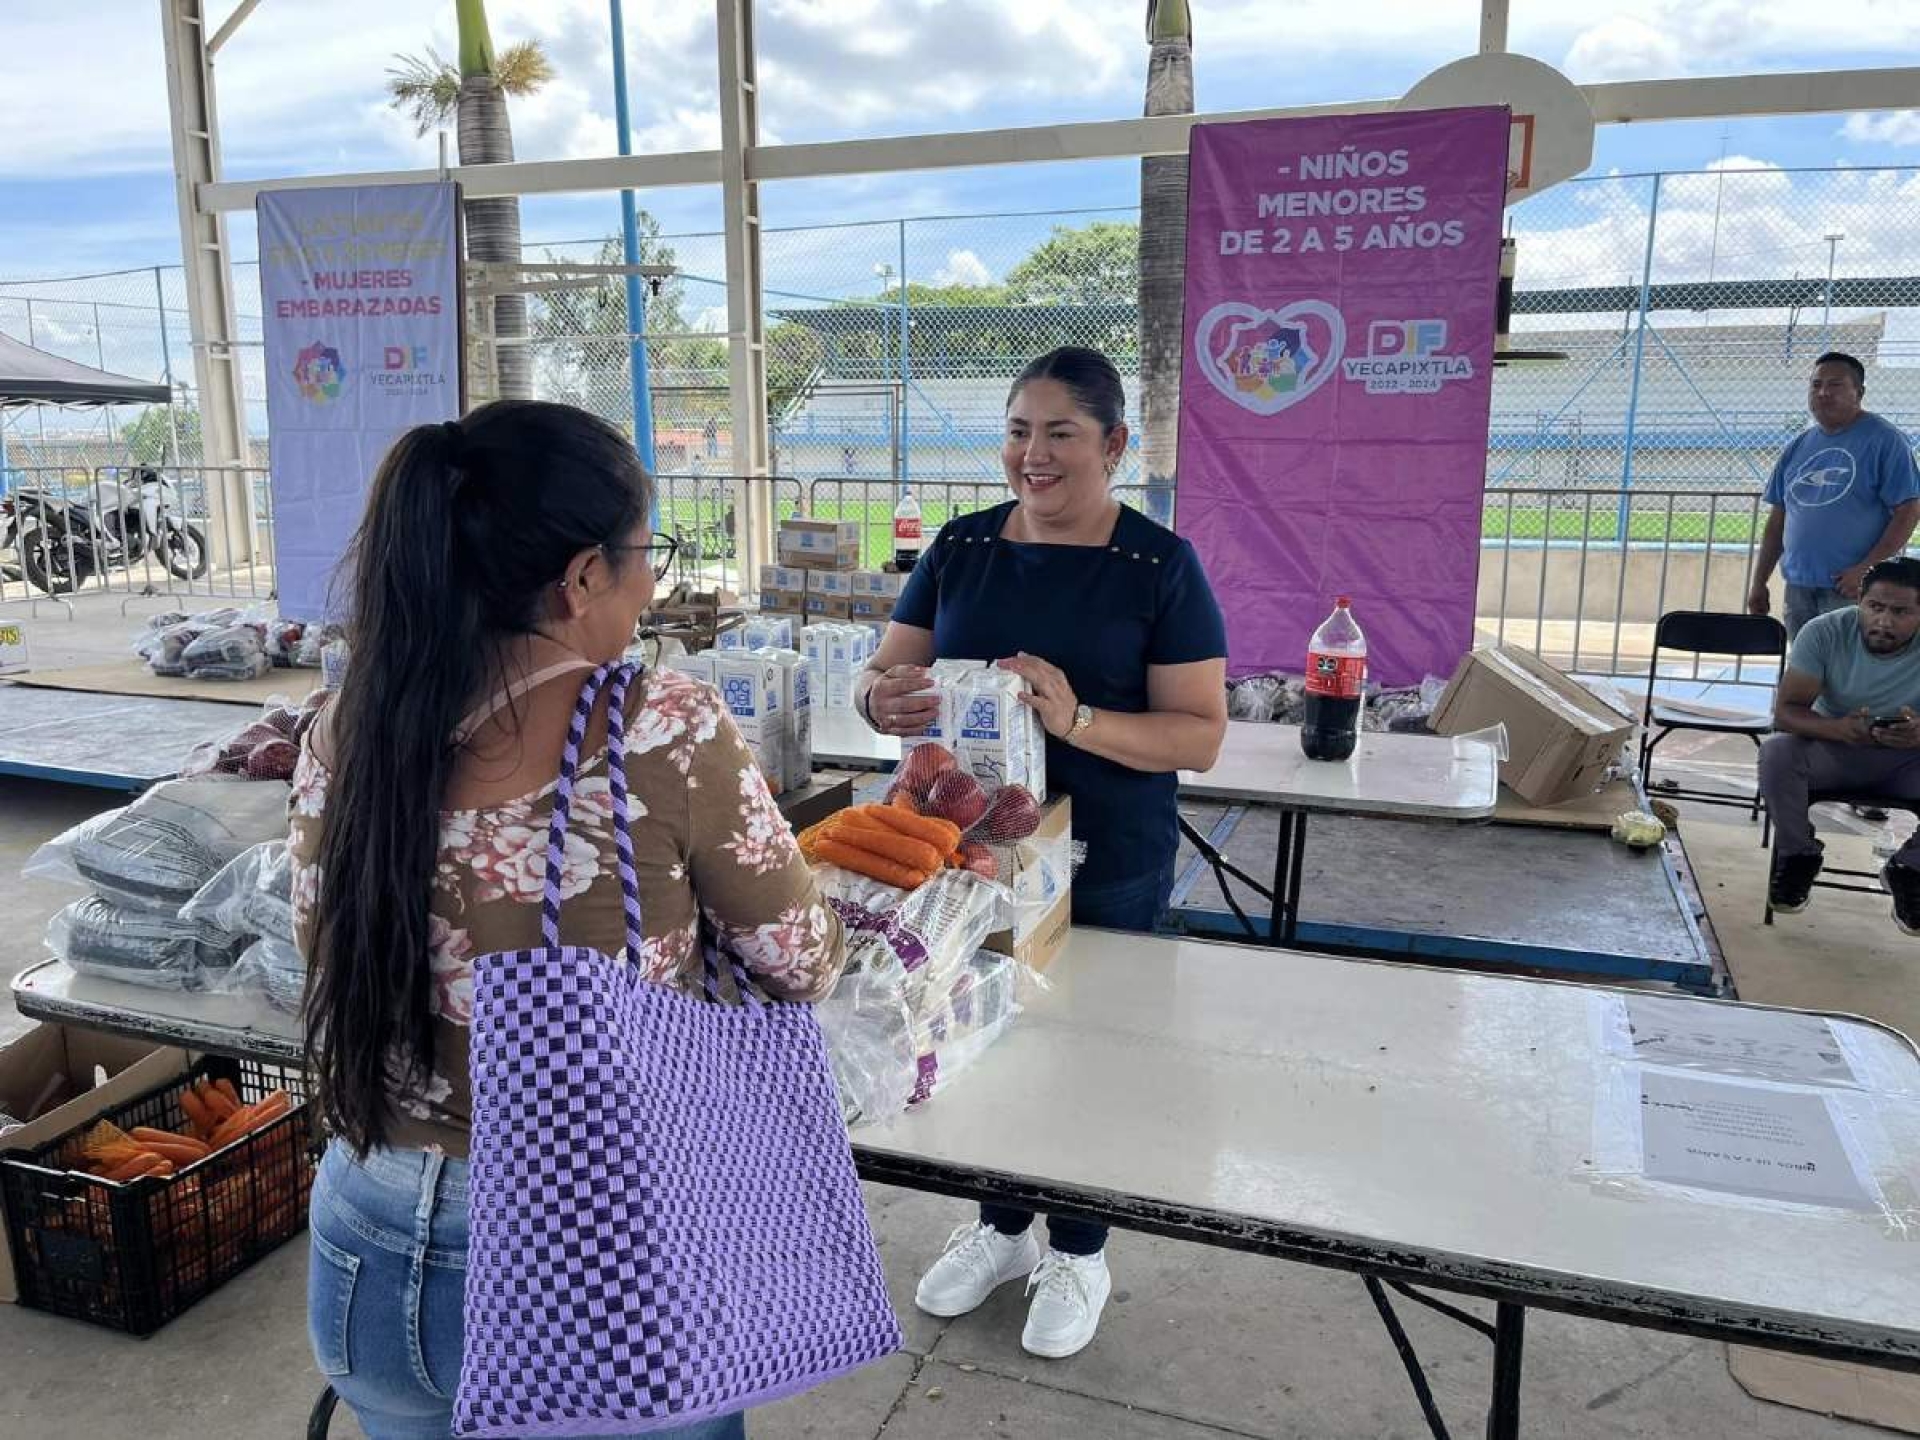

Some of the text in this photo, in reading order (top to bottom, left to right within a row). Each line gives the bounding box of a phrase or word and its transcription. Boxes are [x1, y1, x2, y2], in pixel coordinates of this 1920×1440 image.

[1300, 145, 1409, 180] NIÑOS
[1258, 186, 1426, 219] MENORES
[1220, 216, 1465, 255] DE 2 A 5 AÑOS
[314, 270, 413, 291] MUJERES
[276, 296, 441, 318] EMBARAZADAS
[1371, 323, 1445, 358] DIF
[384, 346, 428, 370] DIF
[1346, 360, 1468, 376] YECAPIXTLA
